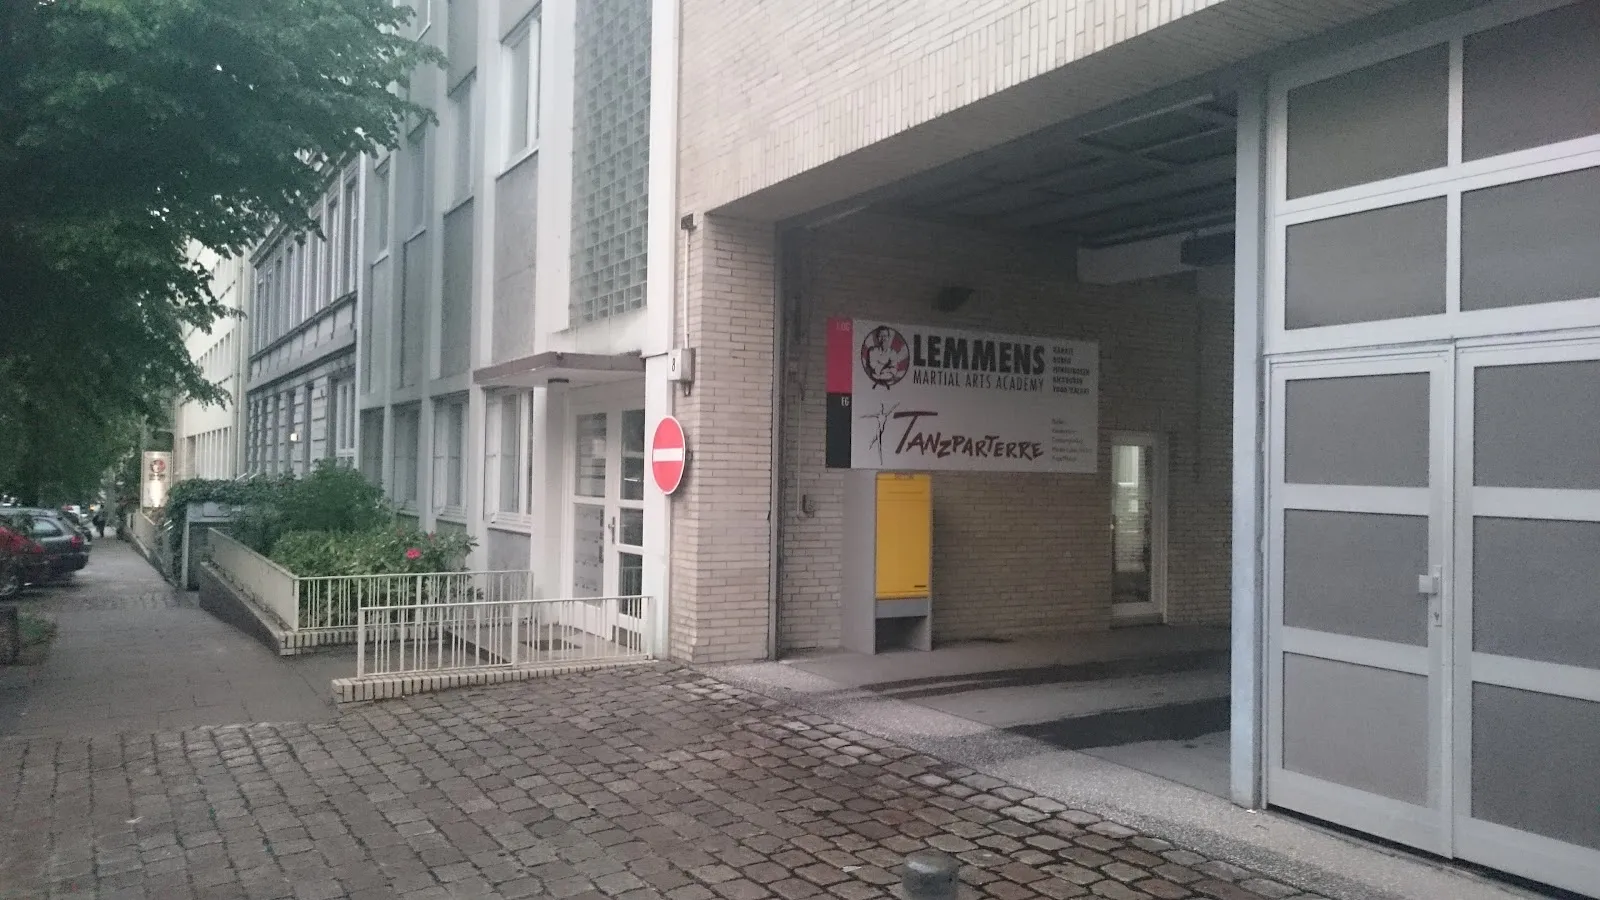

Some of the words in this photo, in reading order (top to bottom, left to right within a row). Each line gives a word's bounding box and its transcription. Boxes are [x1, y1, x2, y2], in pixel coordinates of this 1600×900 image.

[913, 334, 1045, 376] LEMMENS
[913, 369, 960, 387] MARTIAL
[965, 373, 990, 389] ARTS
[996, 374, 1044, 393] ACADEMY
